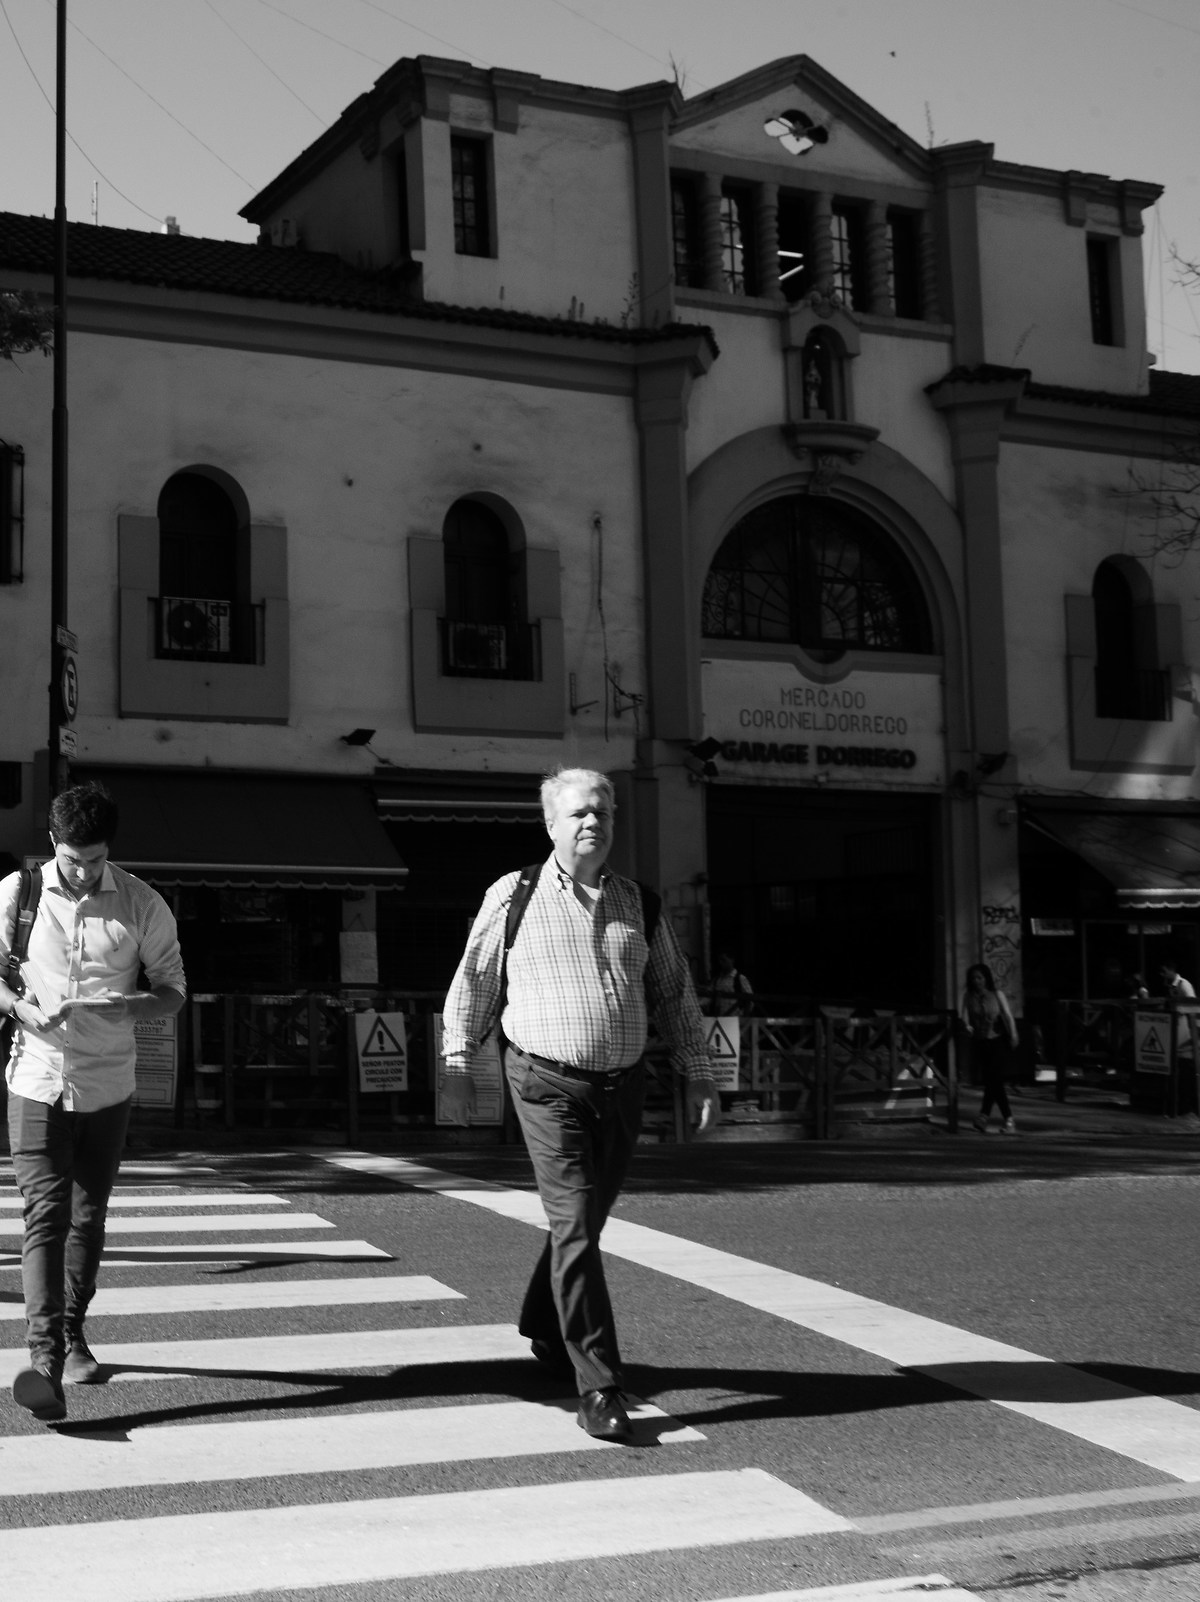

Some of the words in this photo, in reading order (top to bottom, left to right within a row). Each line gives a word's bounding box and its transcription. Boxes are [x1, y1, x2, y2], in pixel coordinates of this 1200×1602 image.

[780, 687, 866, 709] MERCADO
[739, 708, 824, 731] CORONEL
[825, 712, 908, 735] DORREGO
[720, 740, 809, 764] GARAGE
[816, 745, 917, 769] DORREGO
